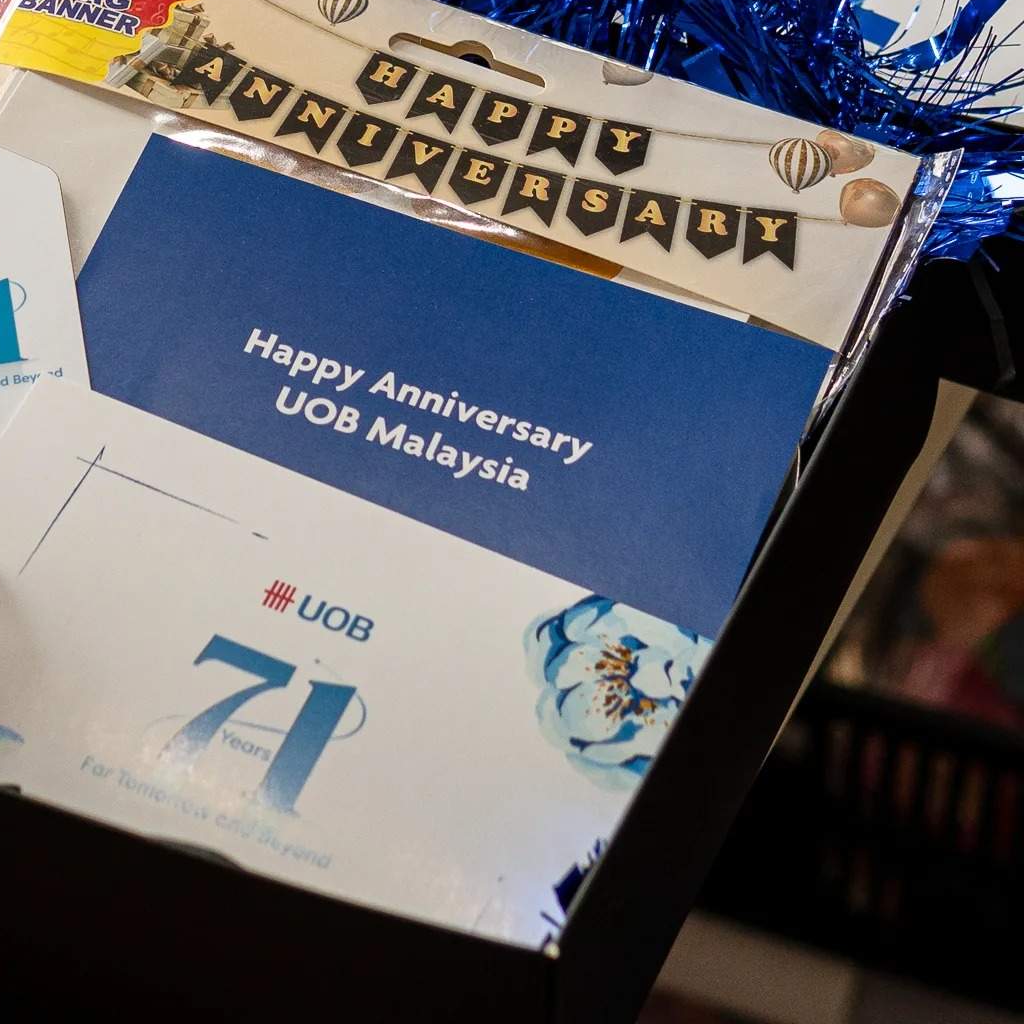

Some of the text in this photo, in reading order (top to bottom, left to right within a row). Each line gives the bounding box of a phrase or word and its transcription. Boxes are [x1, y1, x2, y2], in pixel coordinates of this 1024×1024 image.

[194, 56, 797, 244] ANNIVERSARY
[368, 61, 644, 153] HAPPY
[13, 368, 63, 385] Beyd
[243, 327, 593, 465] Happy Anniversary
[275, 386, 531, 491] UOB Malaysia
[296, 594, 375, 642] UOB
[80, 755, 112, 779] For
[157, 633, 358, 817] 71
[221, 729, 274, 763] Years
